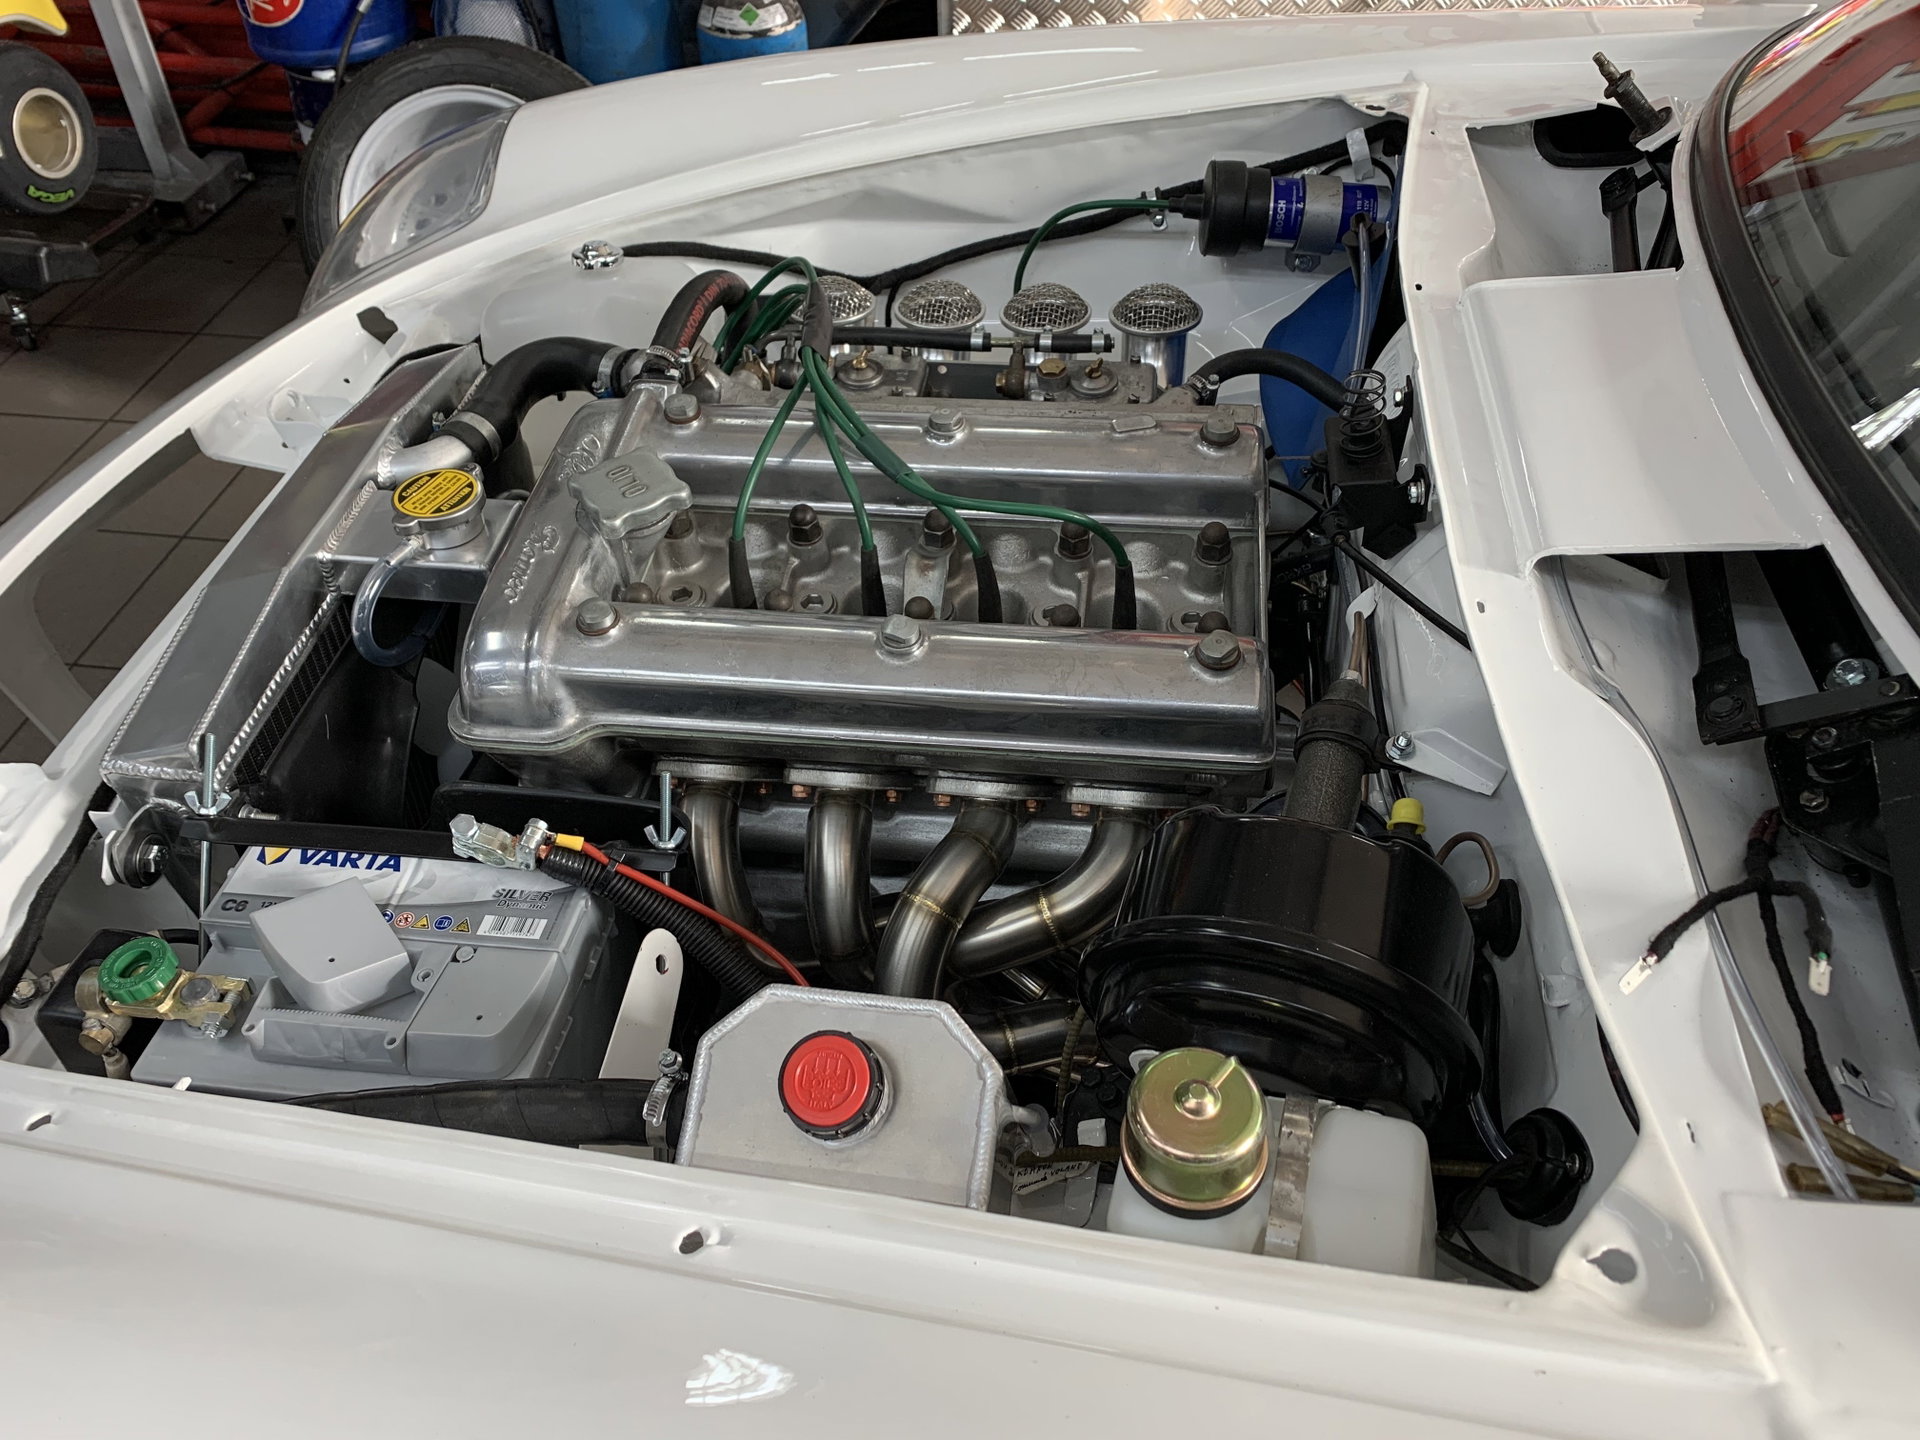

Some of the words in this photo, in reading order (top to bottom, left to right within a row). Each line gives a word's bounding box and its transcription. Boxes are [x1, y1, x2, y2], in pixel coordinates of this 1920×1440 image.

[27, 184, 75, 203] VEGA
[1274, 199, 1287, 234] BOSCH
[402, 475, 431, 497] CAUTION
[606, 464, 647, 498] OLIO
[440, 486, 472, 512] ATTENTION
[299, 846, 401, 872] VARTA
[220, 898, 248, 912] C6
[493, 887, 553, 902] SILVER
